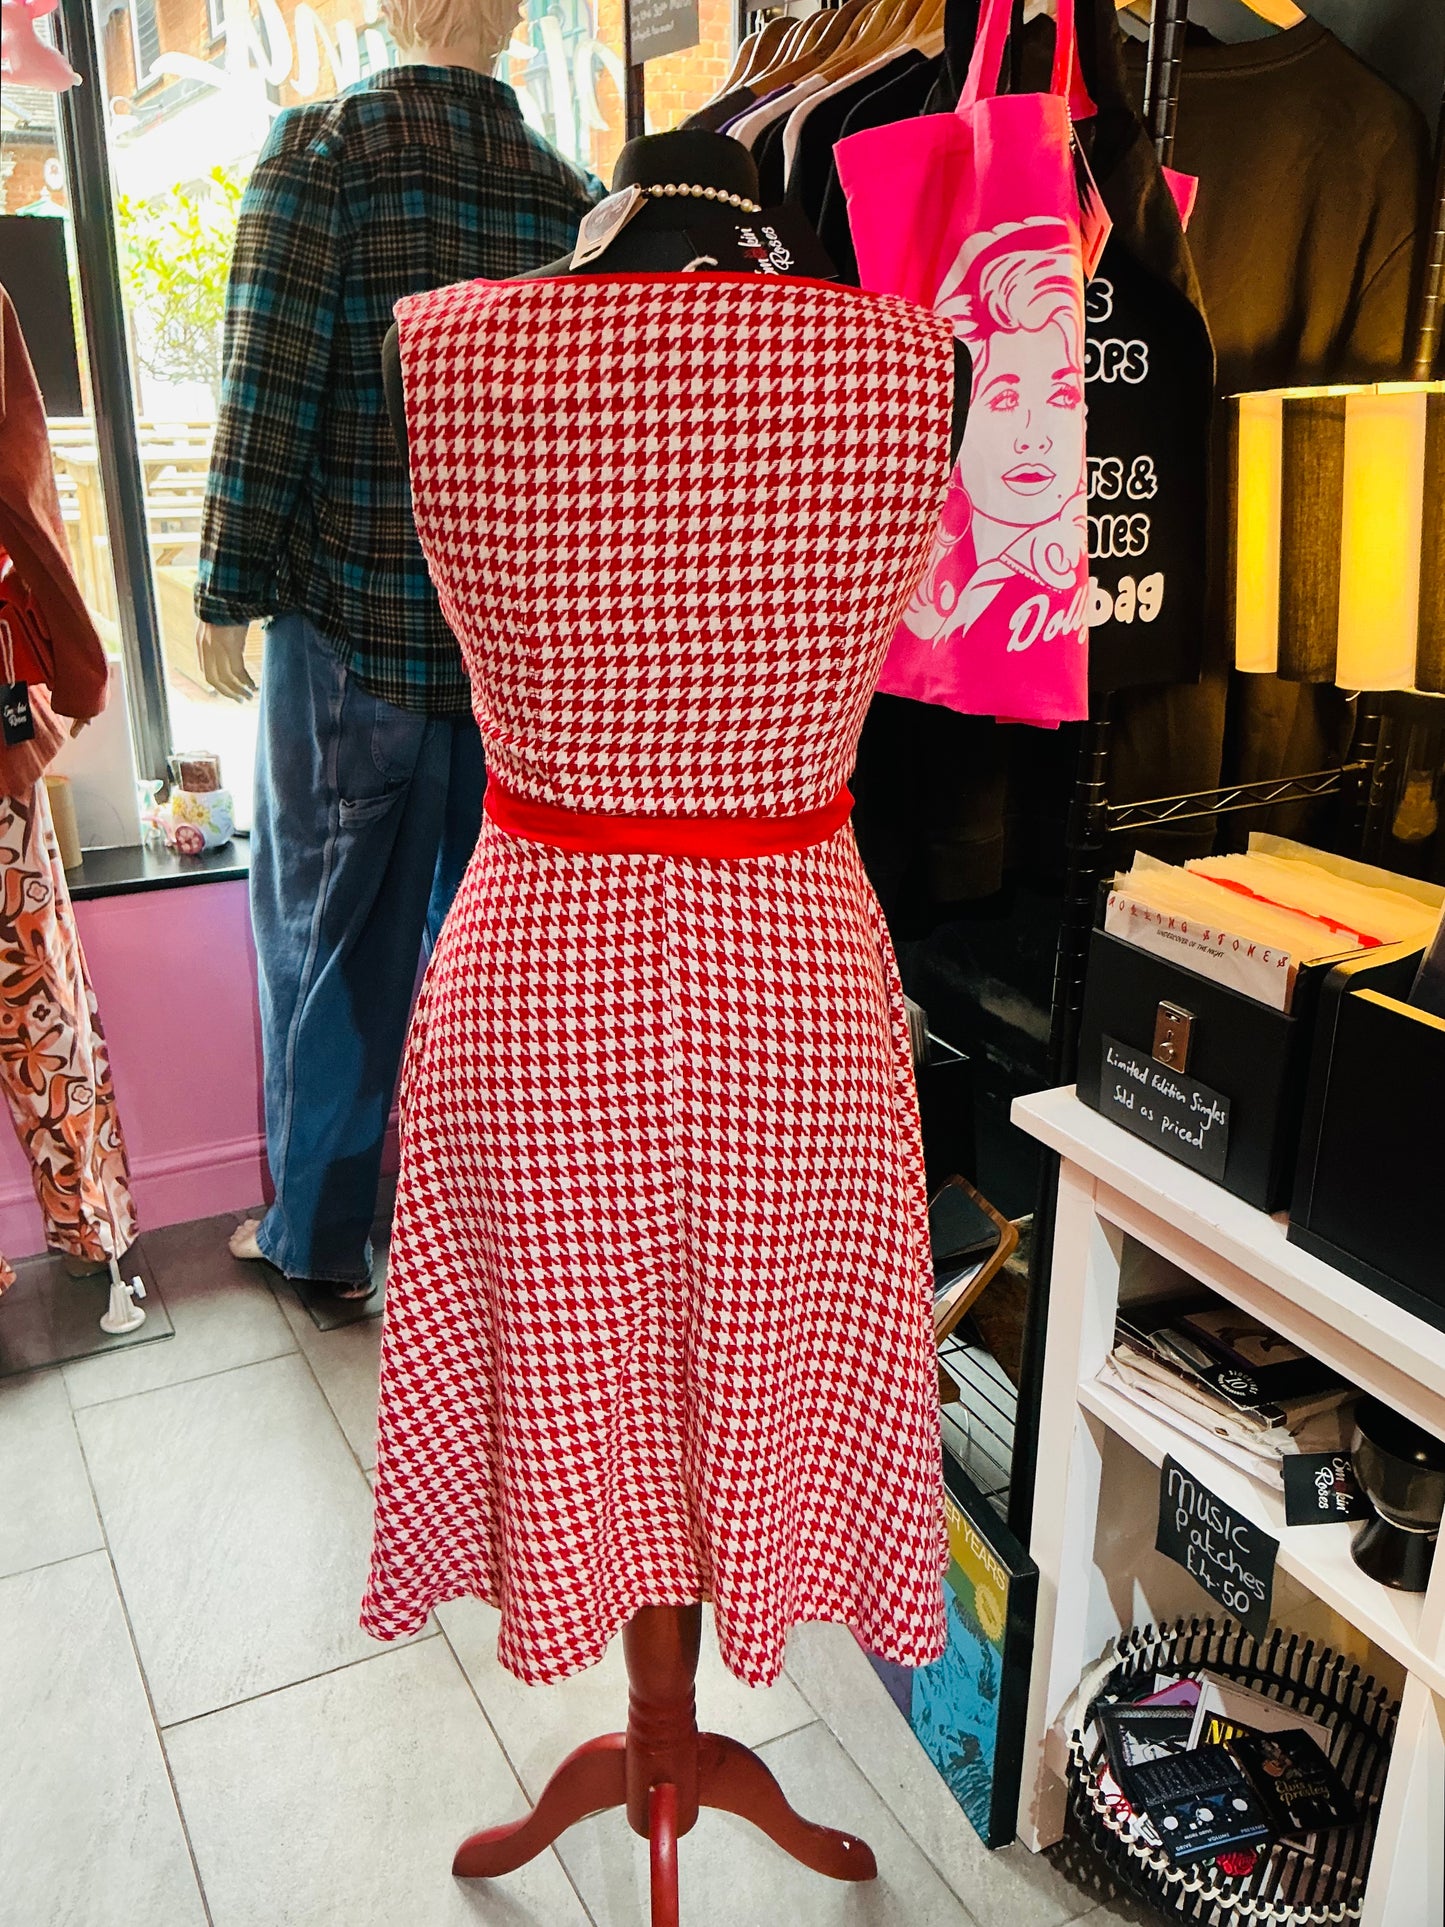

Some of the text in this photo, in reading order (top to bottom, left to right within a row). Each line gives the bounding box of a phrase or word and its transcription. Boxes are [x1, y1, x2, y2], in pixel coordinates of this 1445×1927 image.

[761, 226, 794, 270] Roses
[1085, 338, 1149, 384] OPS
[1087, 456, 1158, 500] TS &
[1157, 929, 1225, 959] UNDERCOVER OF THE NIGHT
[1202, 930, 1289, 968] STONES
[1107, 1047, 1225, 1130] Limited Edition Singles
[1113, 1085, 1203, 1149] Sold as priced
[1314, 1466, 1334, 1509] Roses
[945, 1498, 961, 1532] ER
[963, 1522, 1006, 1591] YEARS
[1187, 1545, 1250, 1612] £4.50
[1207, 1832, 1231, 1843] VOLUME
